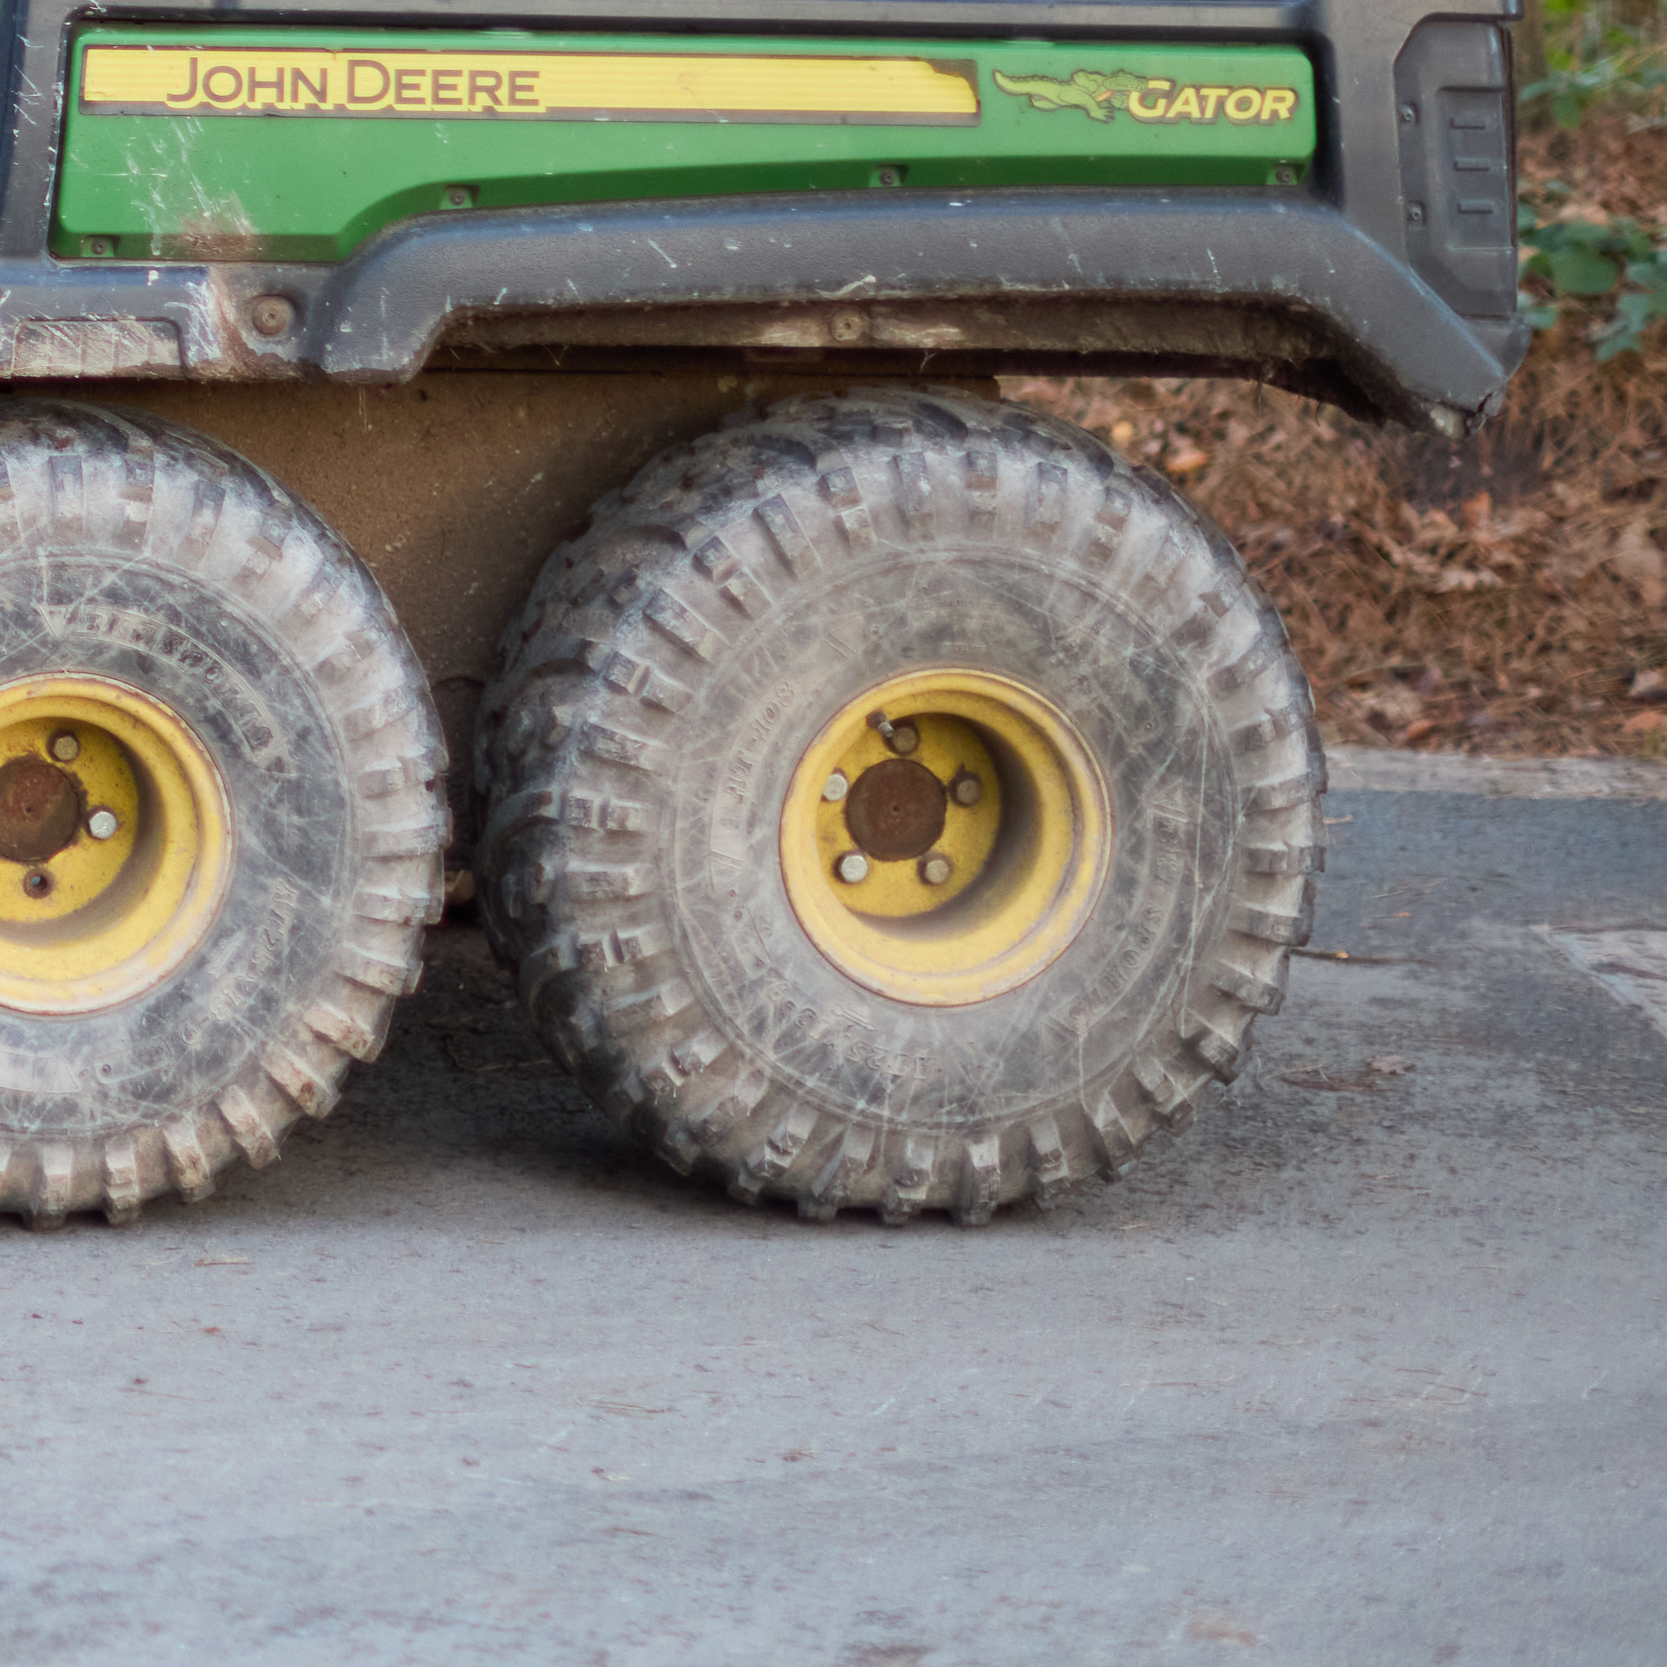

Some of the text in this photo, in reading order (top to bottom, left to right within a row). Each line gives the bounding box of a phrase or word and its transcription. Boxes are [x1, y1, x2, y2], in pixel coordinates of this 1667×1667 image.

[166, 56, 541, 107] JOHN DEERE
[1128, 79, 1297, 121] GATOR
